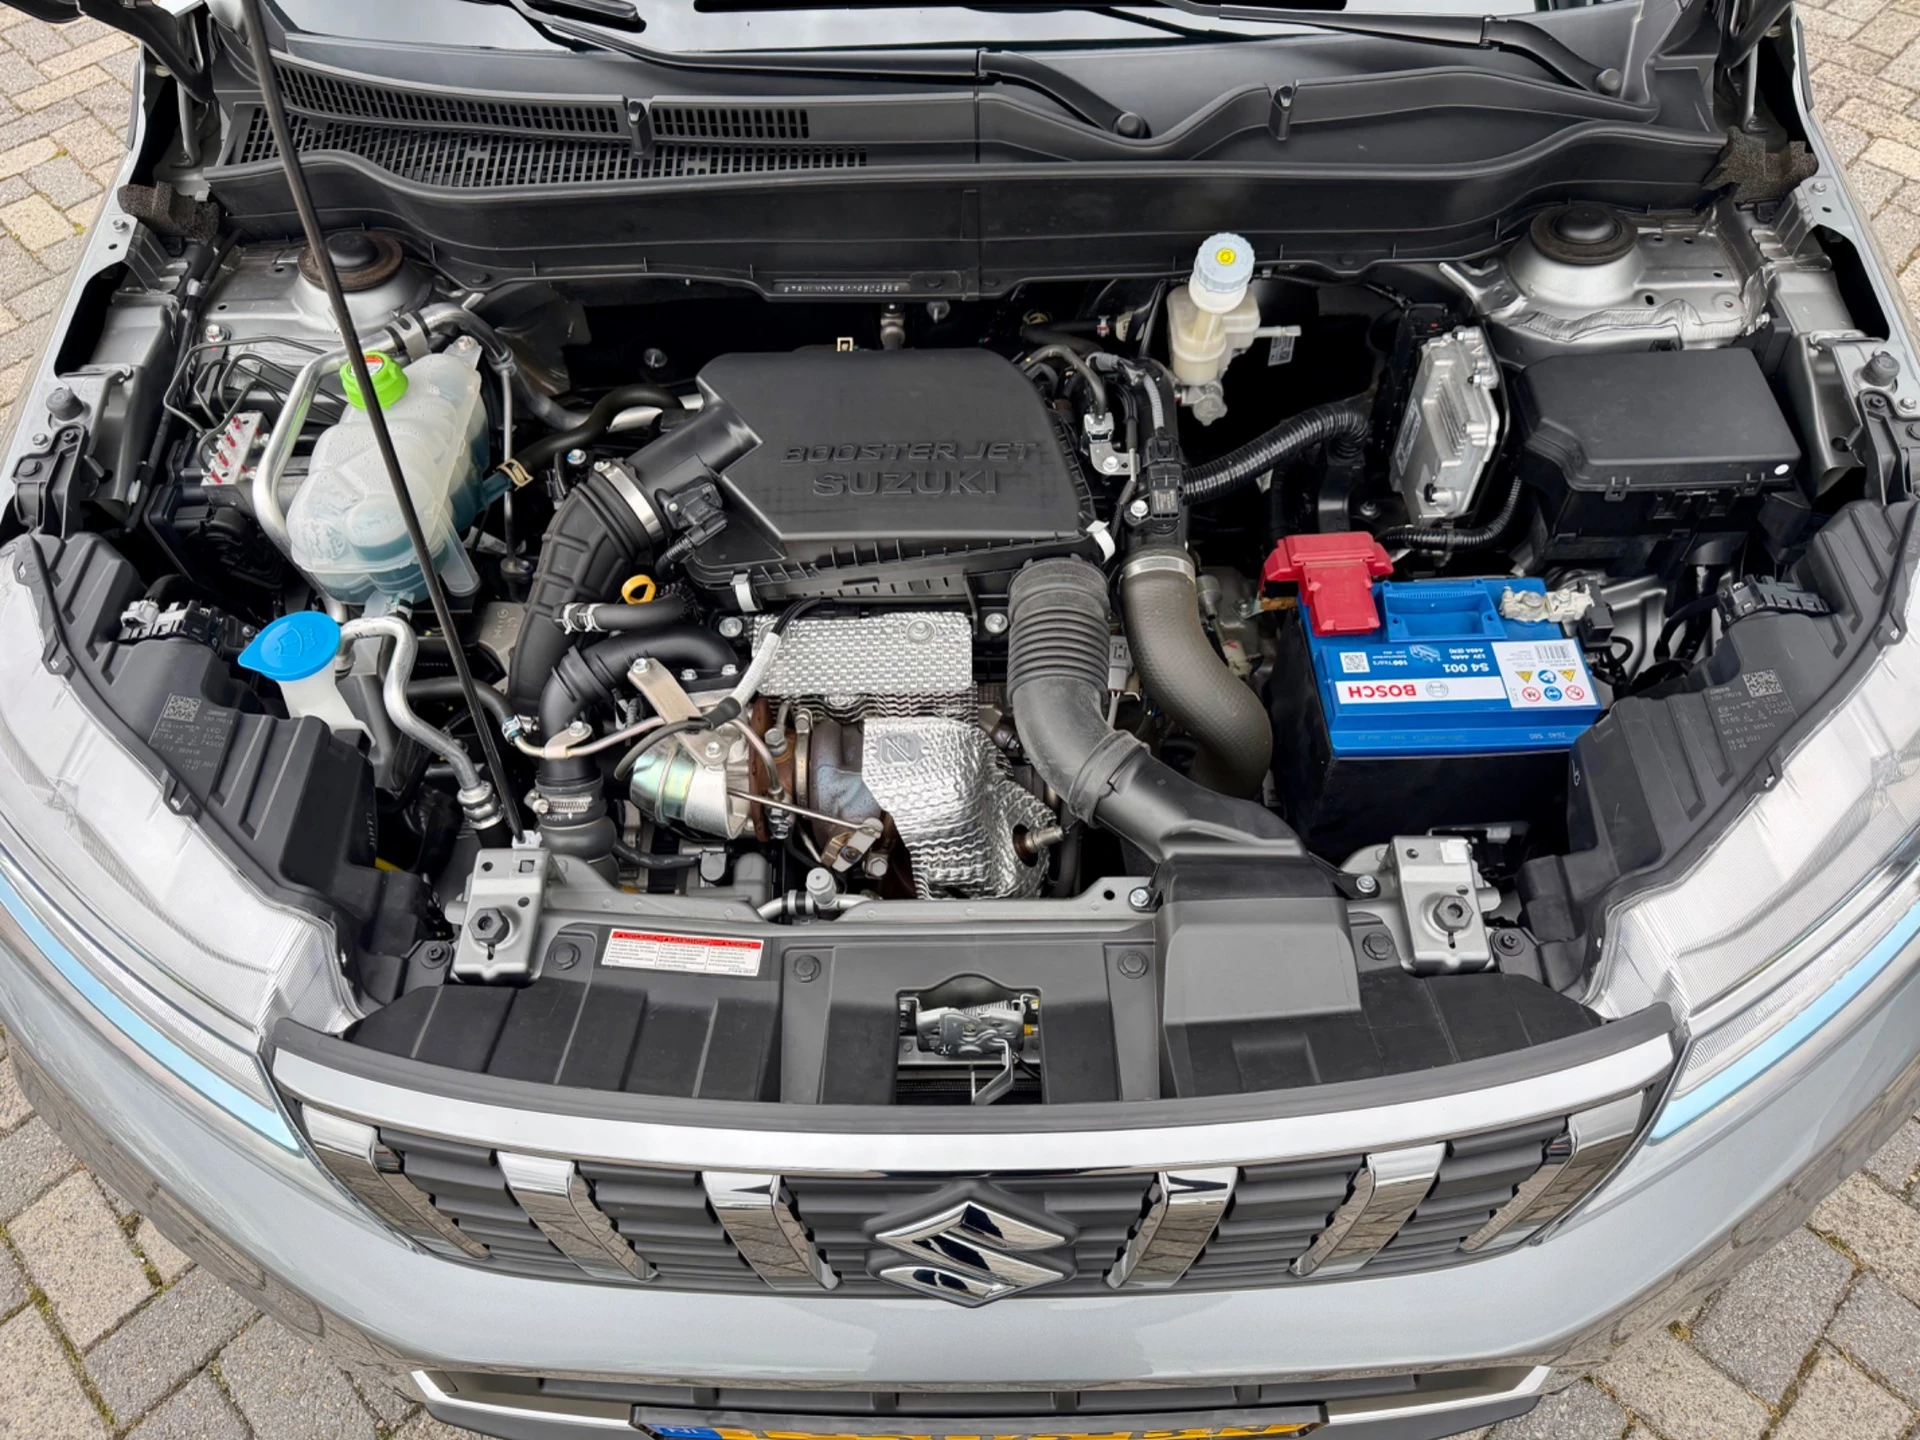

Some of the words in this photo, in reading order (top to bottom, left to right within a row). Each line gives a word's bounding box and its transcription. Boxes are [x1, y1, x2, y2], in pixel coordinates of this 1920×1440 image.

[813, 469, 1000, 497] SUZUKI
[1442, 663, 1468, 673] 001
[1471, 663, 1490, 672] S4
[1348, 684, 1417, 698] BOSCH
